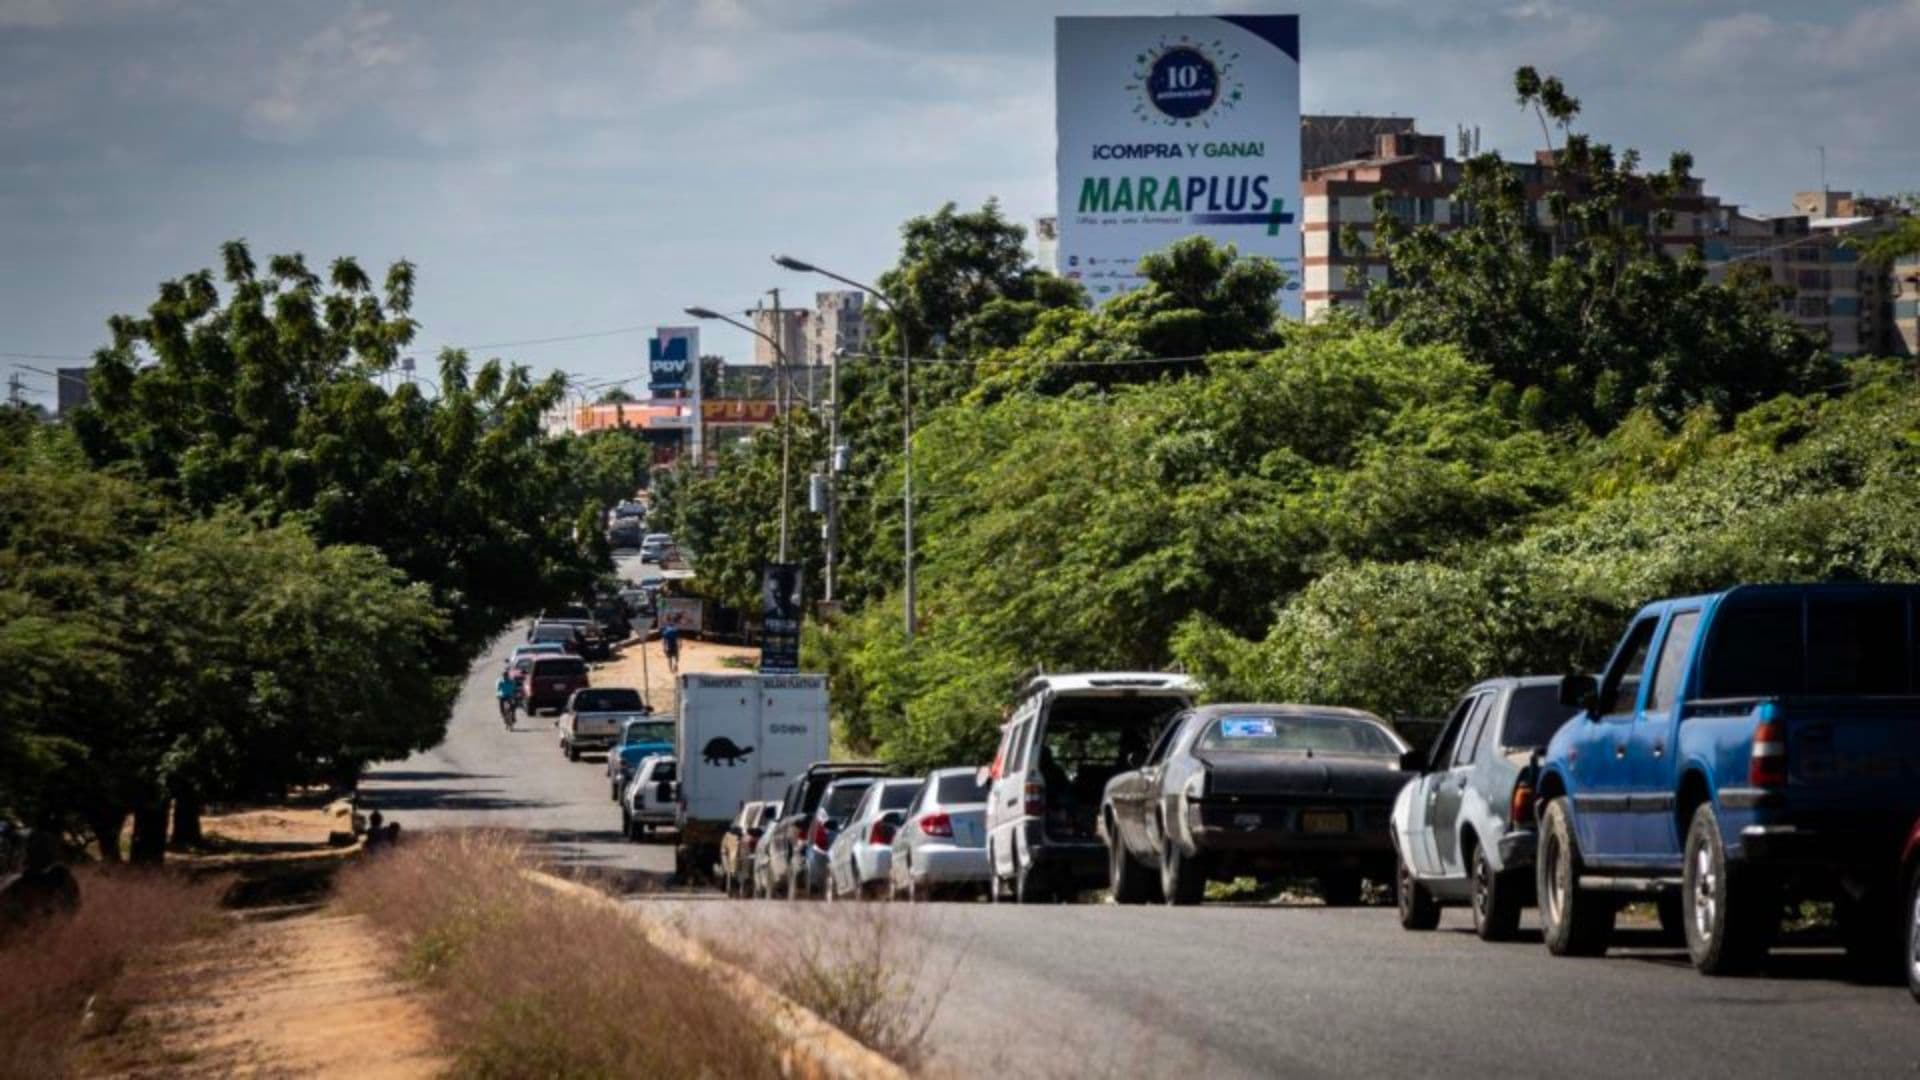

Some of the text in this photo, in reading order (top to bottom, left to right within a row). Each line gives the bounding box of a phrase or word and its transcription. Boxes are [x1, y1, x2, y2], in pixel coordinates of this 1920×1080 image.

[1092, 142, 1265, 160] ¡COMPRA Y GANA!
[652, 359, 686, 372] PDV
